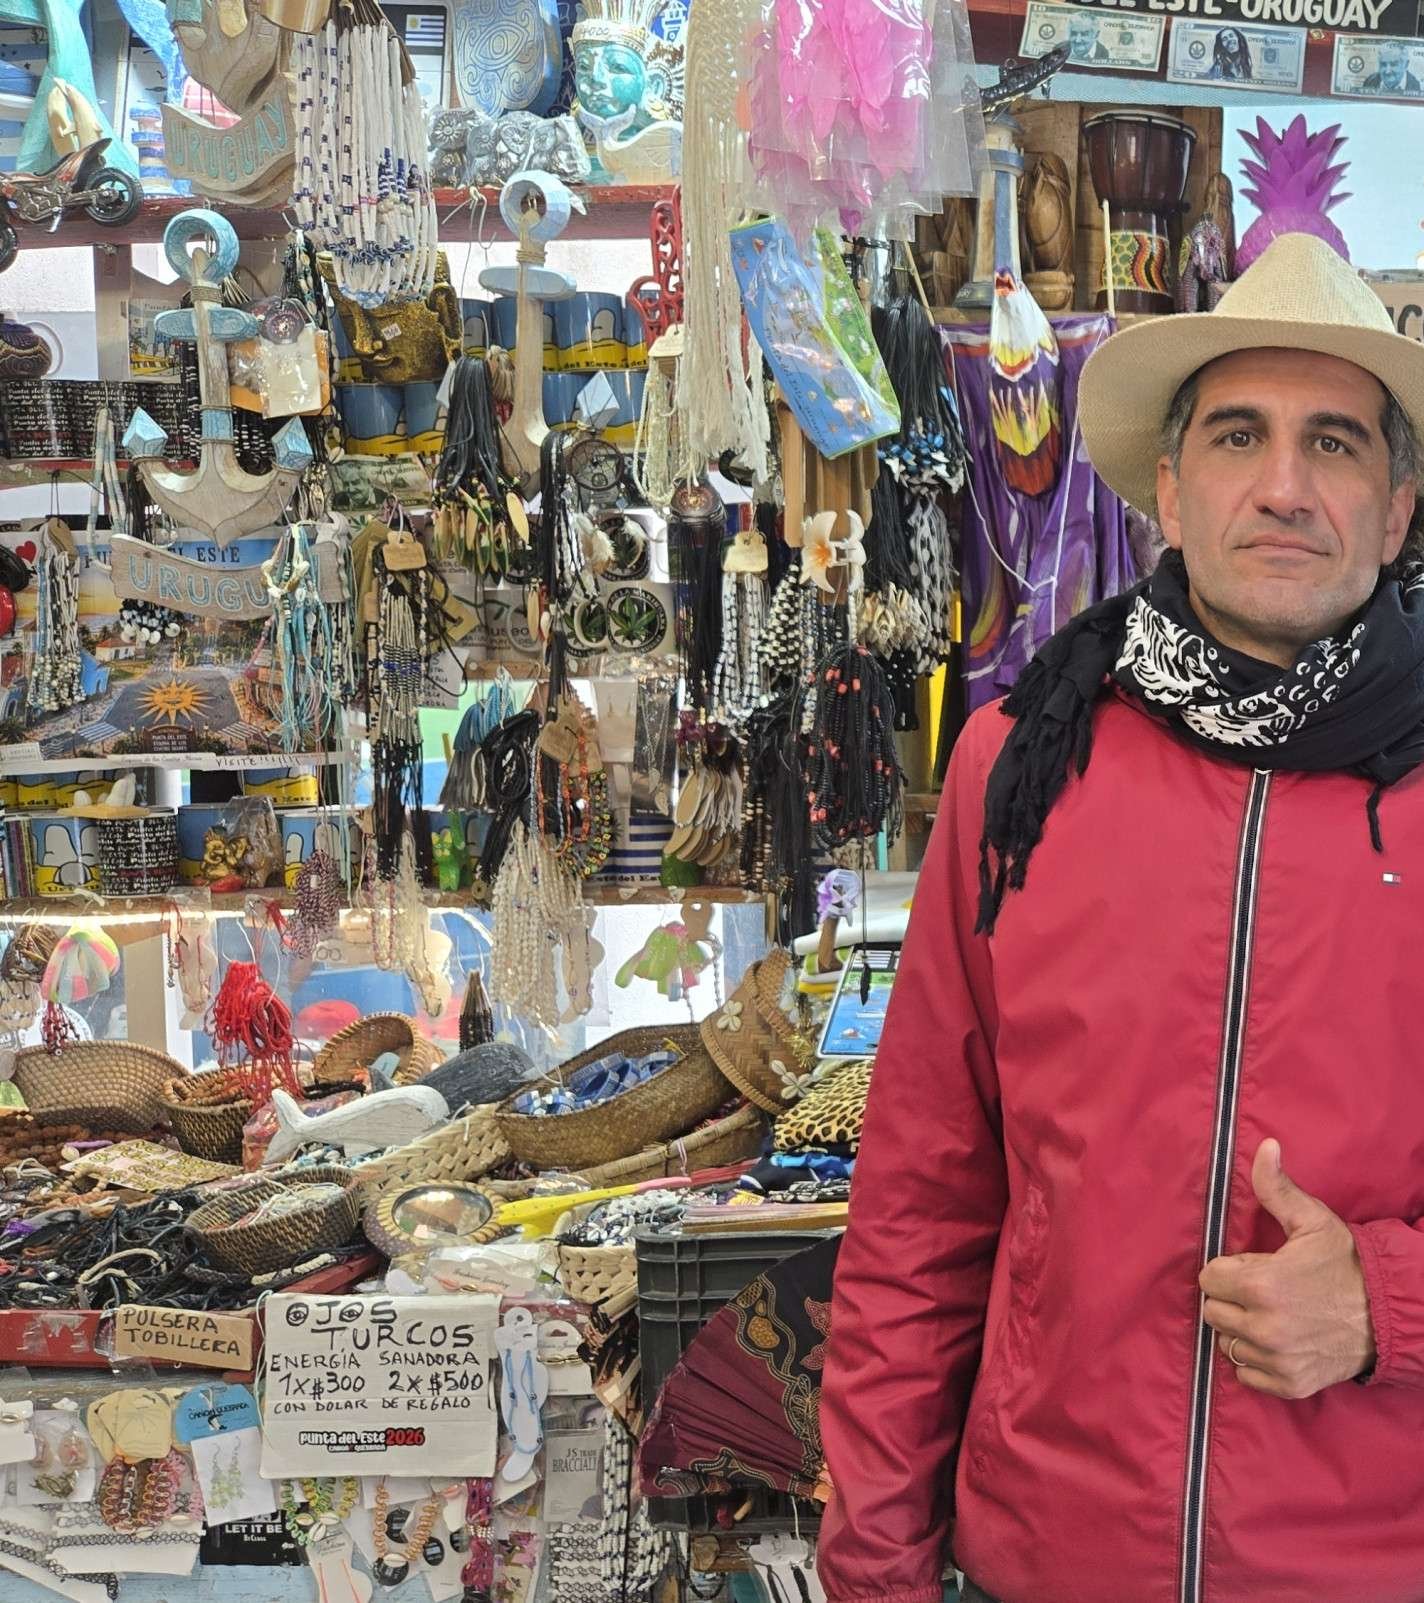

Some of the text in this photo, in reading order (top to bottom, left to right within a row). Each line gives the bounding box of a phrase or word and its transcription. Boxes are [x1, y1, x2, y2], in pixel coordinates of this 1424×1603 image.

[171, 96, 288, 183] URUGUAY
[198, 546, 240, 563] ESTE
[128, 553, 275, 612] URUGU
[123, 1308, 218, 1333] PULSERA
[286, 1301, 398, 1326] OJOS
[124, 1328, 241, 1356] TOBILLERA
[311, 1321, 475, 1351] TURCOS
[379, 1351, 480, 1367] SANADORA
[274, 1398, 471, 1414] CON DOLAR DE REGALO
[386, 1428, 425, 1446] 2026
[226, 1524, 282, 1534] LET IT BE
